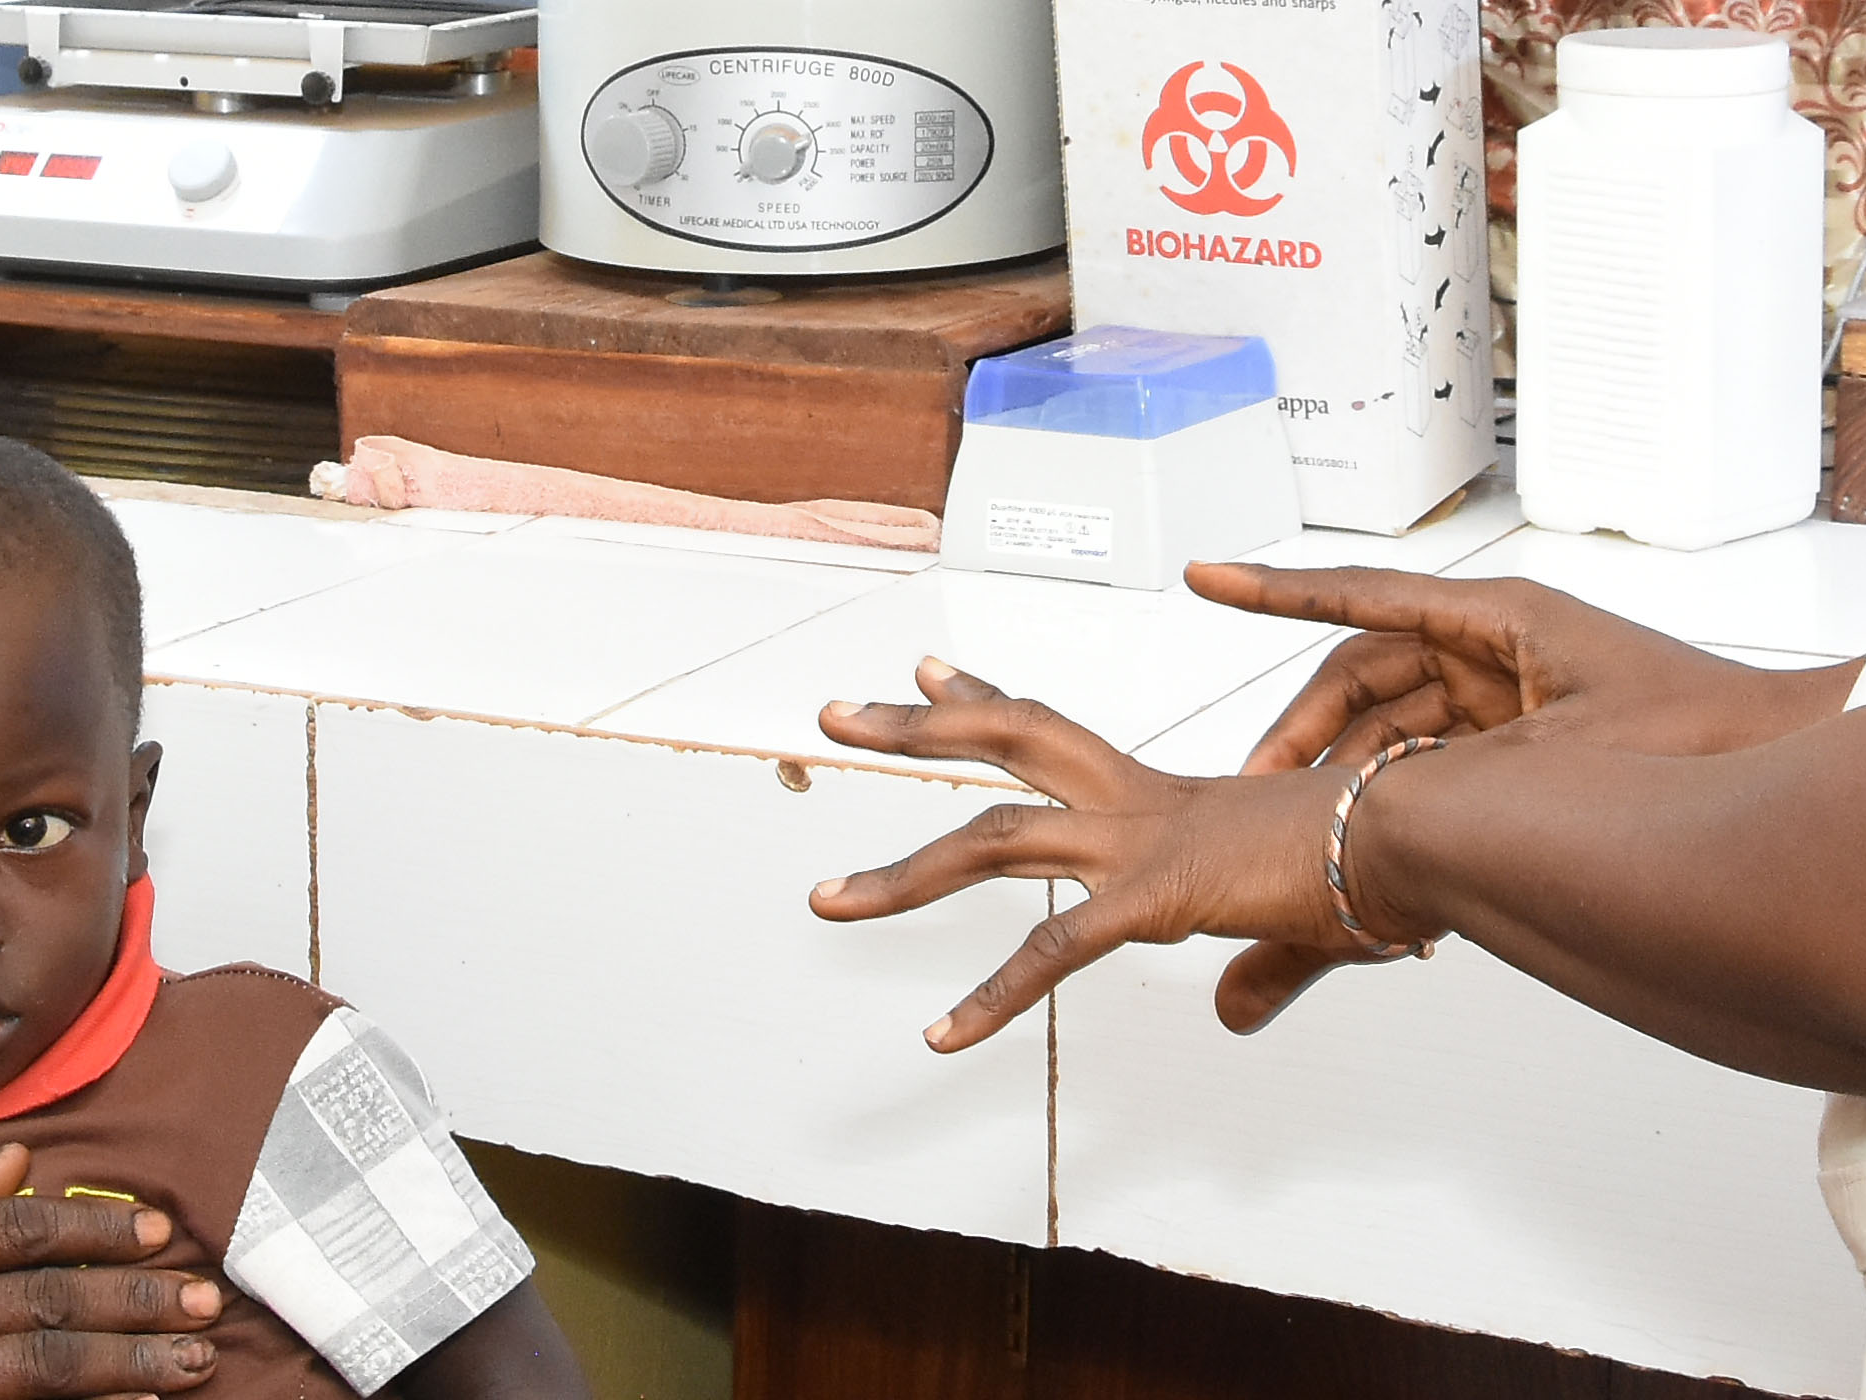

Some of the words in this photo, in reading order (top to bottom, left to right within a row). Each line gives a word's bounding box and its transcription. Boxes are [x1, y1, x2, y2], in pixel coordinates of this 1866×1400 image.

[661, 70, 696, 81] LIFECARE
[709, 58, 835, 77] CENTRIFUGE
[849, 66, 895, 87] 800D
[870, 114, 895, 124] SPEED
[850, 144, 890, 153] CAPACITY
[850, 158, 875, 168] POWER
[850, 173, 875, 182] POWER
[879, 171, 908, 181] SOURCE
[639, 194, 671, 206] TIMER
[758, 202, 801, 214] SPEED
[680, 216, 719, 228] LIFECARE
[723, 218, 765, 230] MEDICAL
[768, 220, 785, 230] LTD
[788, 220, 807, 230] USA
[811, 220, 881, 231] TECHNOLOGY
[1126, 228, 1322, 269] BIOHAZARD
[1277, 395, 1329, 420] appa
